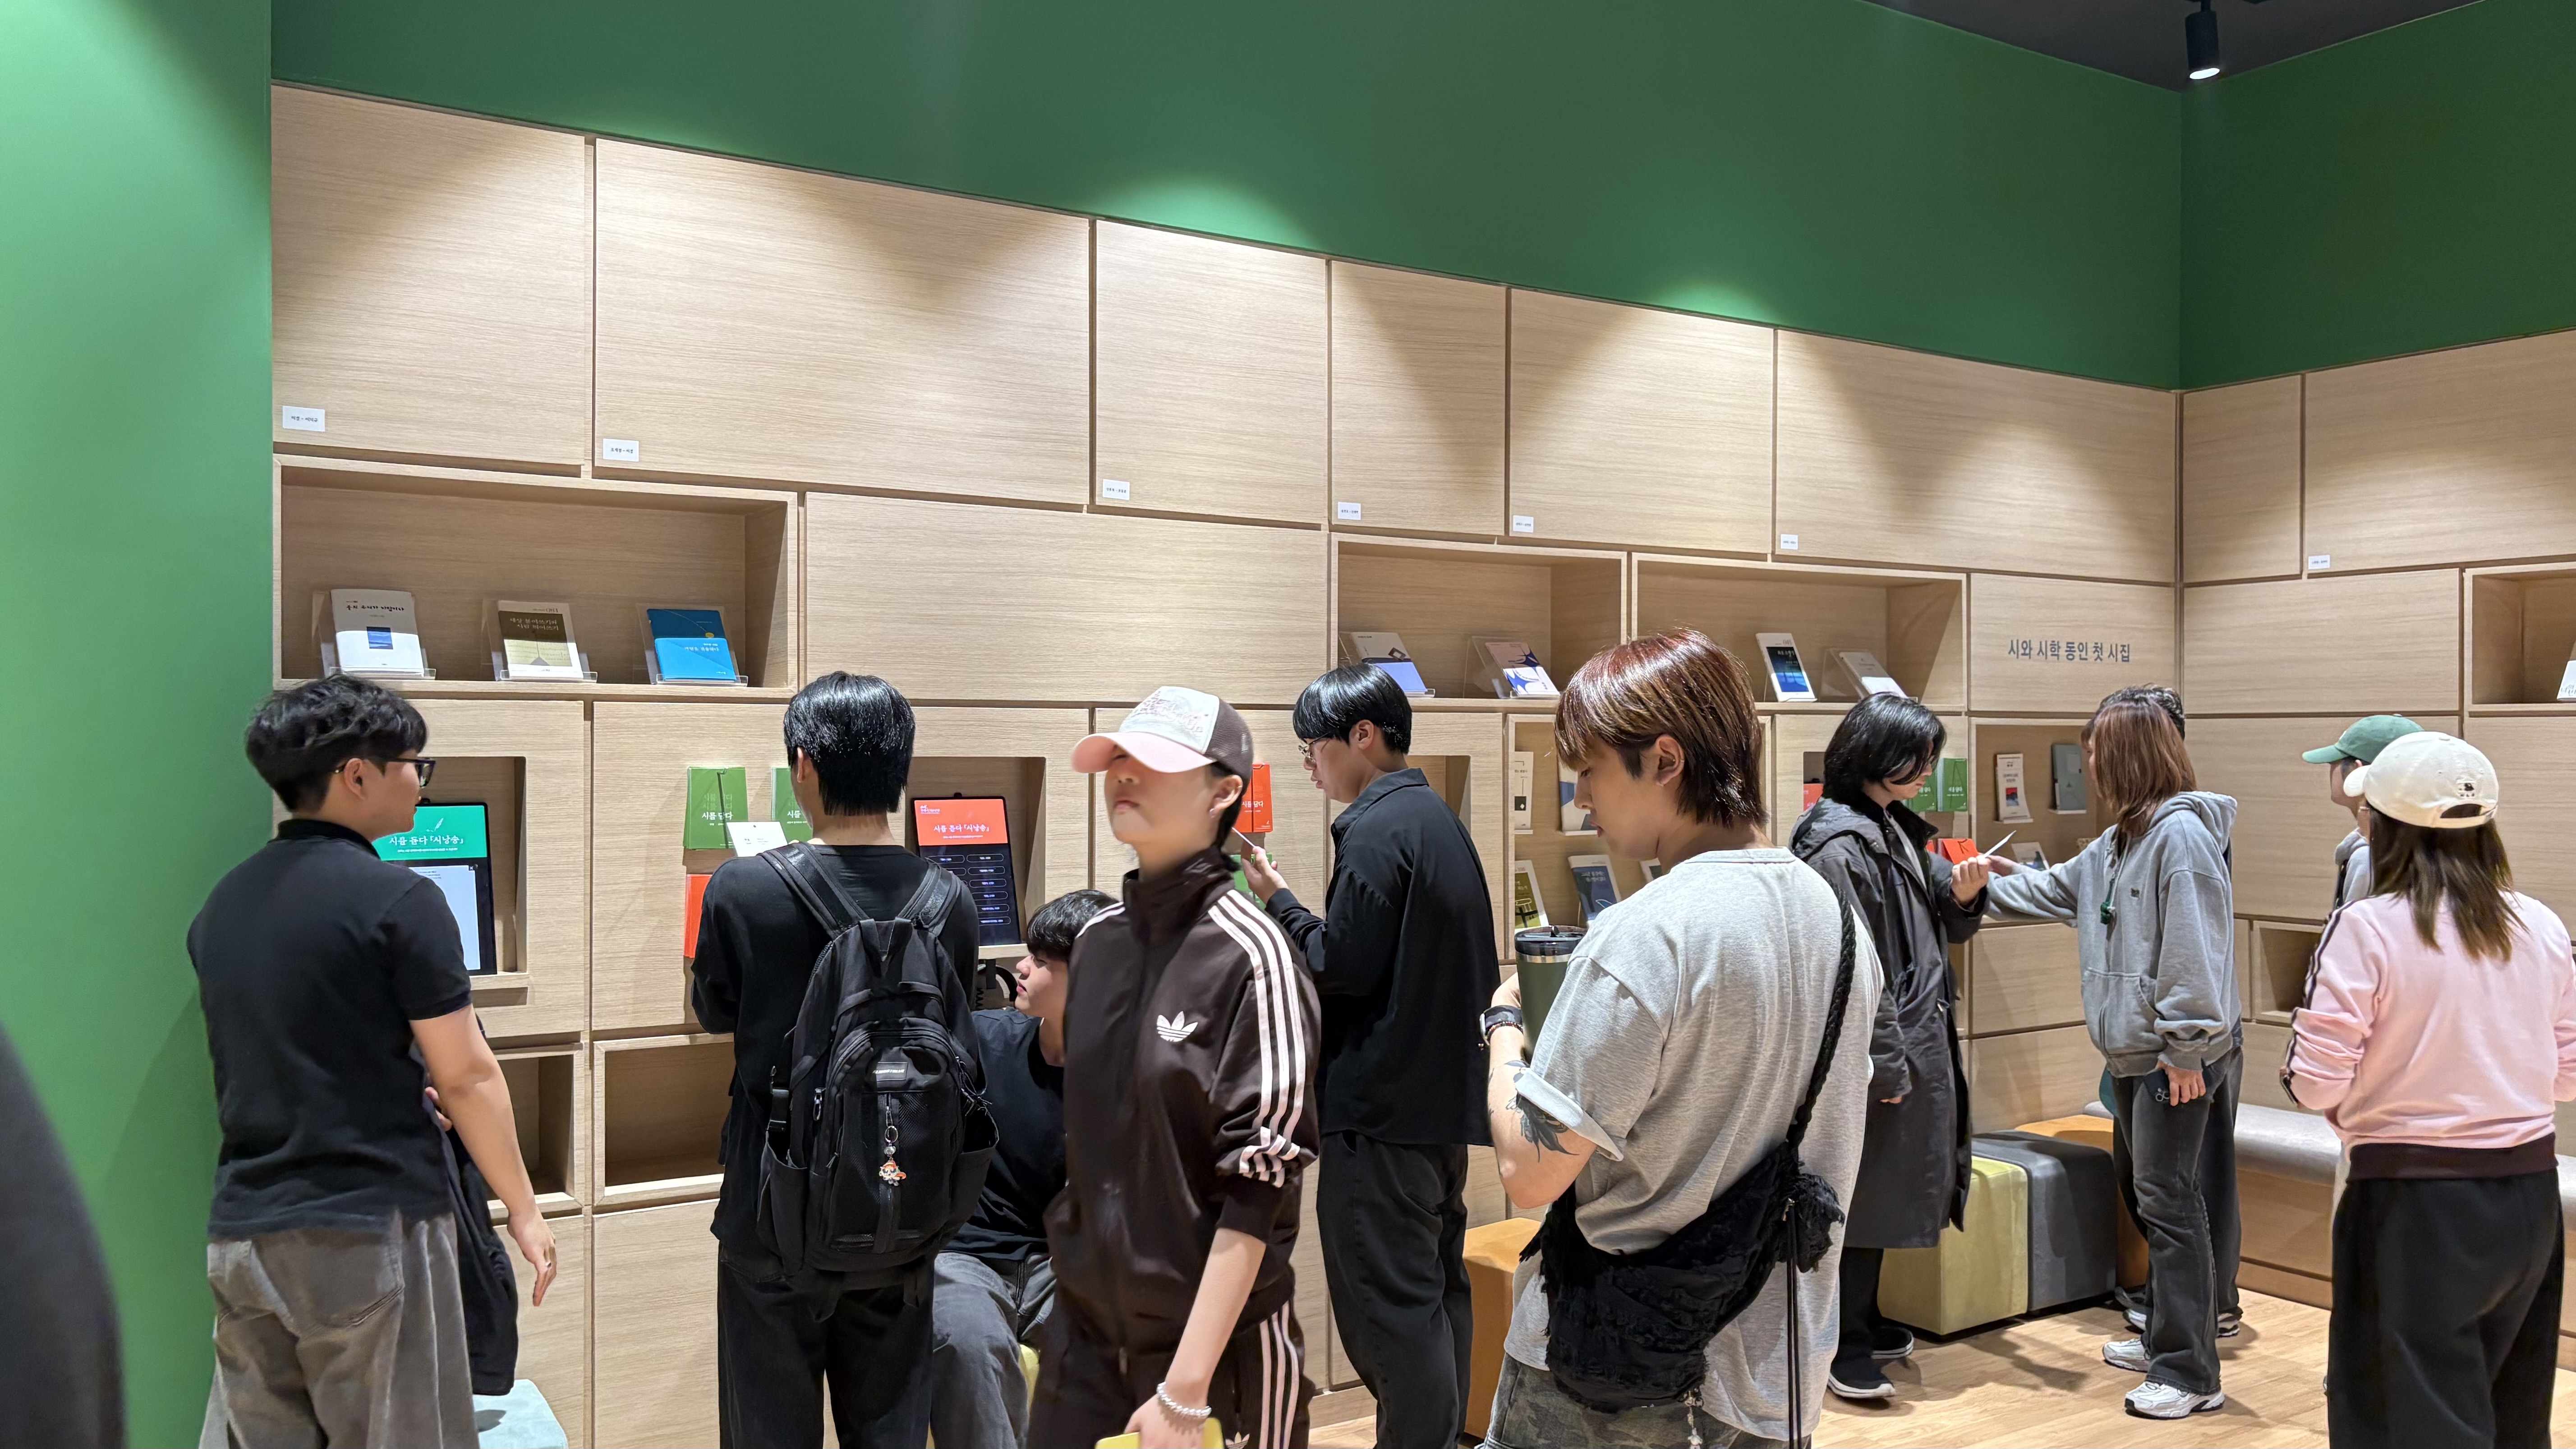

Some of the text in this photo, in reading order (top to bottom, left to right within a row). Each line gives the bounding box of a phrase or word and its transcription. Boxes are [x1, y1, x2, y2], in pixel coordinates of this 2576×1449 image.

[2008, 639, 2130, 662] 시와 시학 동인 첫 시집
[701, 811, 734, 820] 시를 담다
[787, 810, 801, 819] 시를
[934, 824, 948, 833] 시를
[964, 823, 989, 832] 「시낭송」
[389, 835, 464, 846] 시를 듣다 「시낭송」
